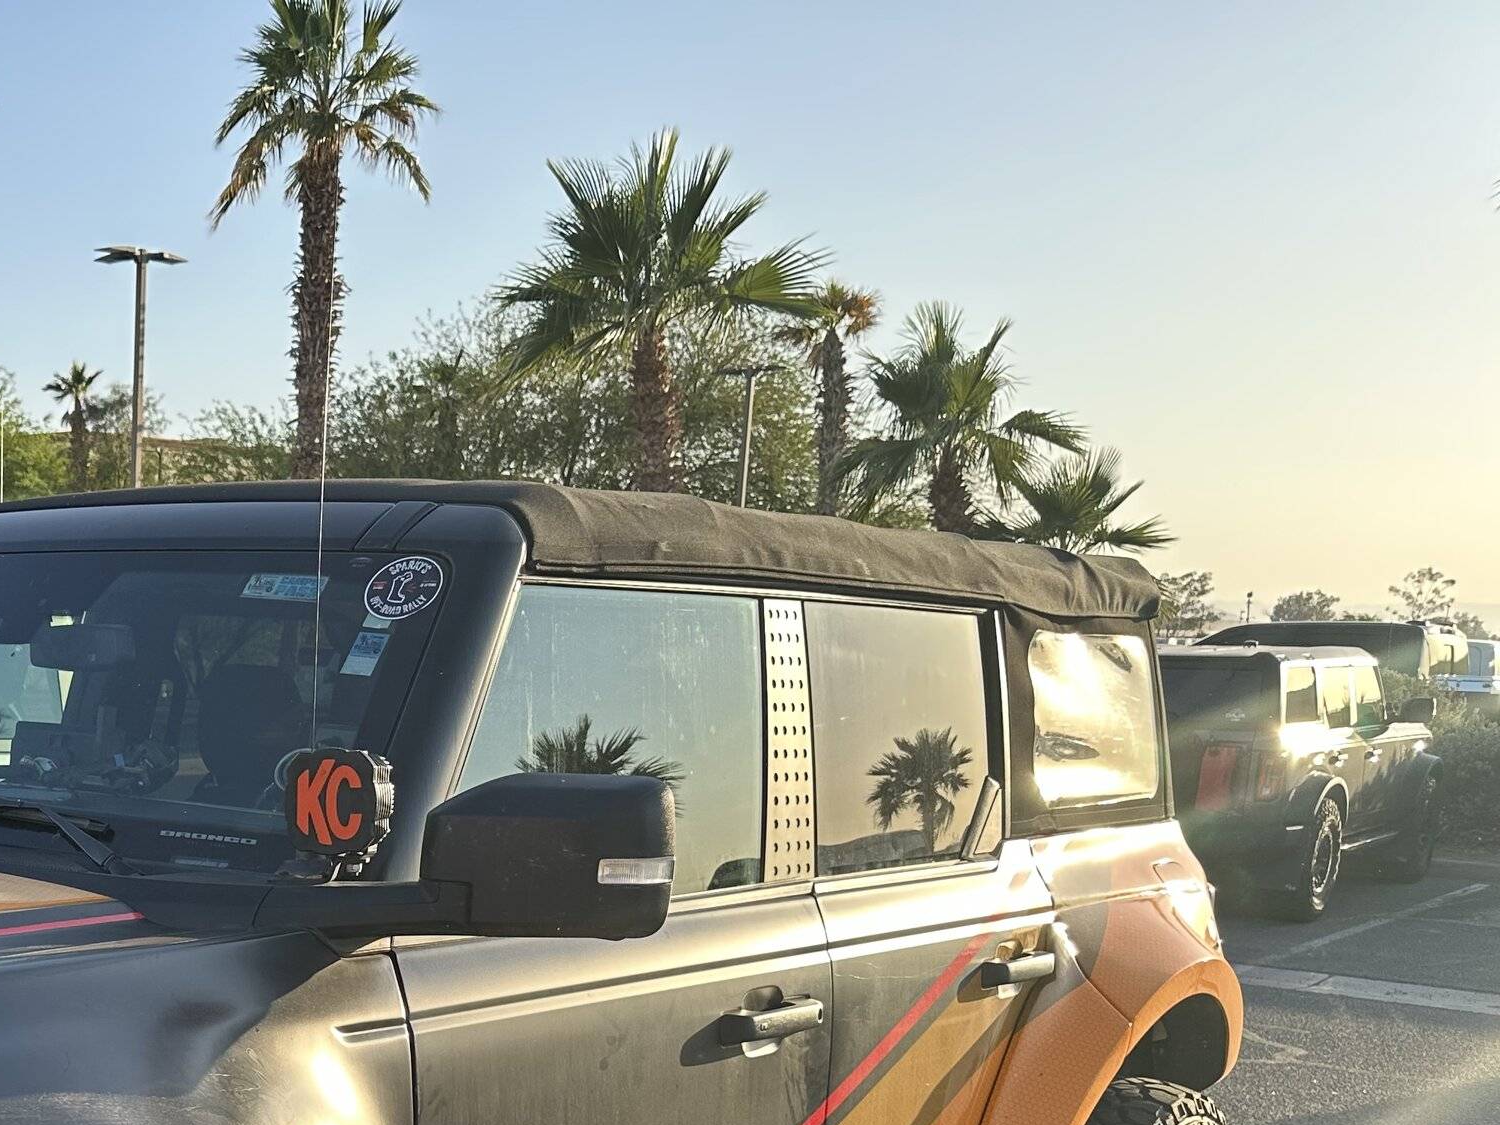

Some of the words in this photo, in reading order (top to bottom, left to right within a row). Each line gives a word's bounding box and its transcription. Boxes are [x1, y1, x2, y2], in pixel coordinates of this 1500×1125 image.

[388, 560, 432, 575] SPARKY'S
[402, 594, 427, 613] RALLY
[296, 759, 362, 845] KC
[160, 830, 257, 845] BRONCO
